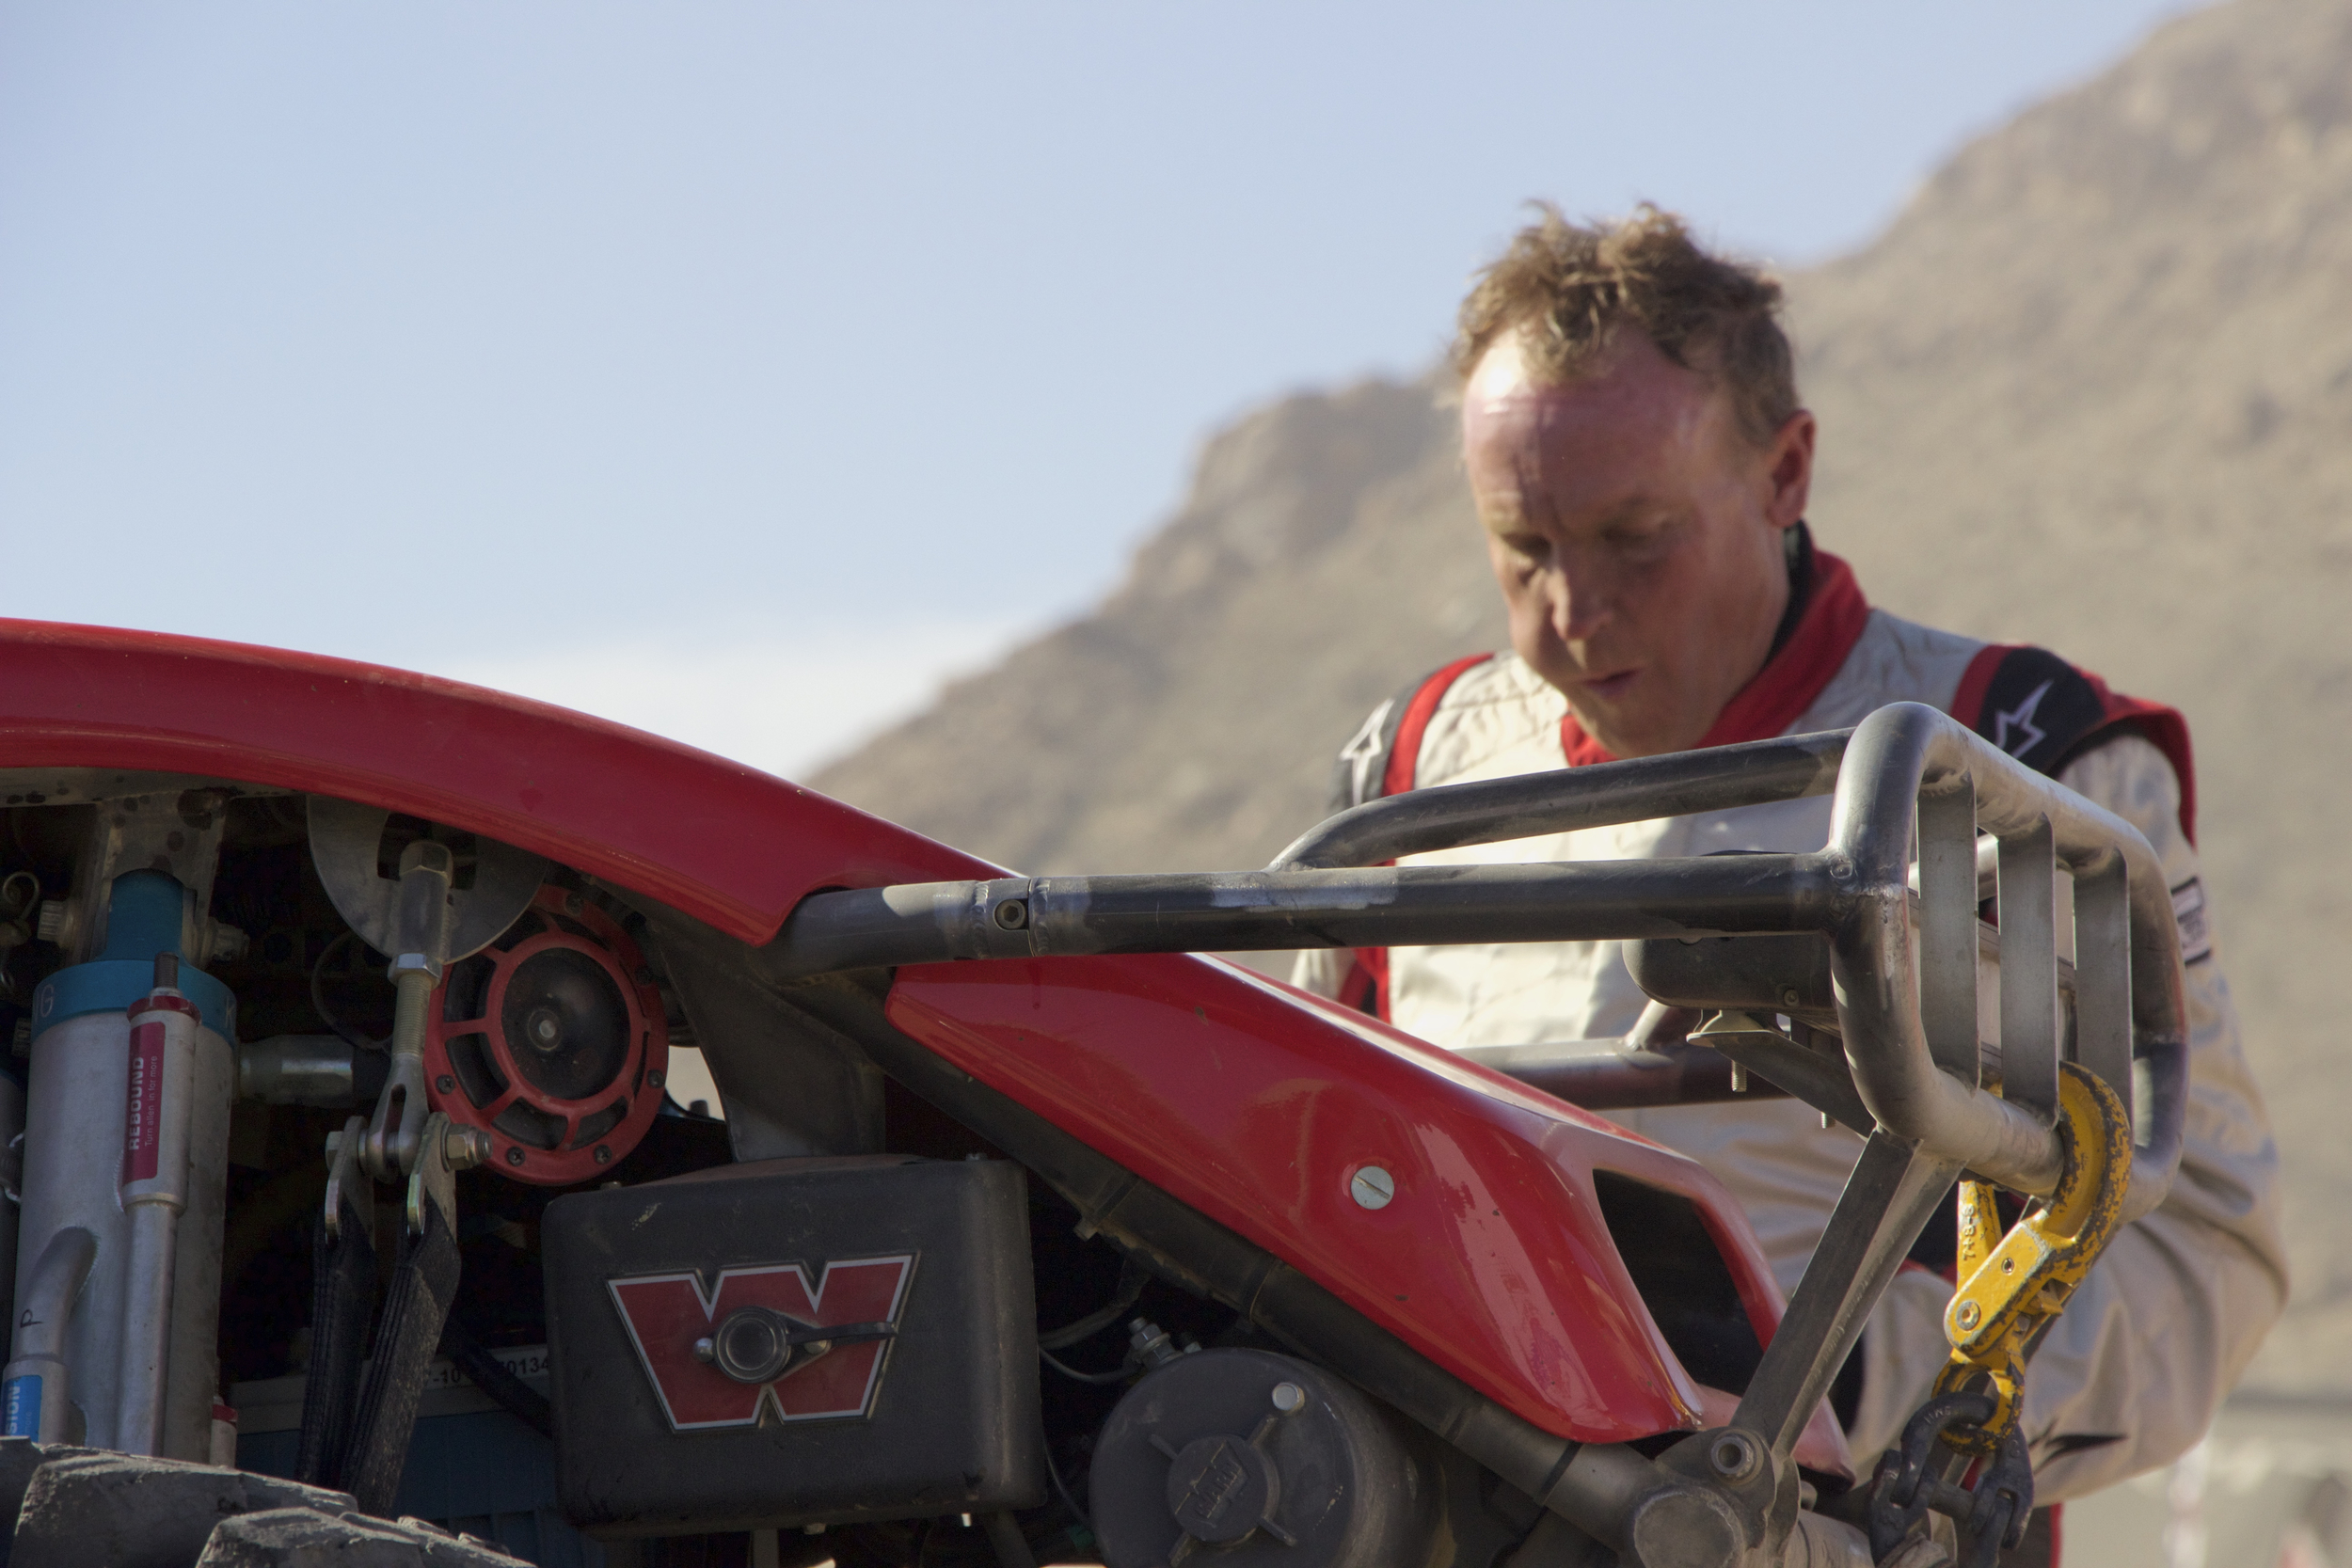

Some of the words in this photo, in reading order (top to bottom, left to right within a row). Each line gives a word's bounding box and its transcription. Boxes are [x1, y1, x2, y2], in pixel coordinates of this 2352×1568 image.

[129, 1056, 144, 1150] REBOUND
[148, 1093, 155, 1101] in
[147, 1105, 155, 1126] allen
[145, 1128, 154, 1146] Turn
[20, 1308, 44, 1329] P
[607, 1250, 921, 1434] W
[427, 1368, 461, 1385] -10
[504, 1357, 549, 1375] 0134
[6, 1386, 20, 1434] SION
